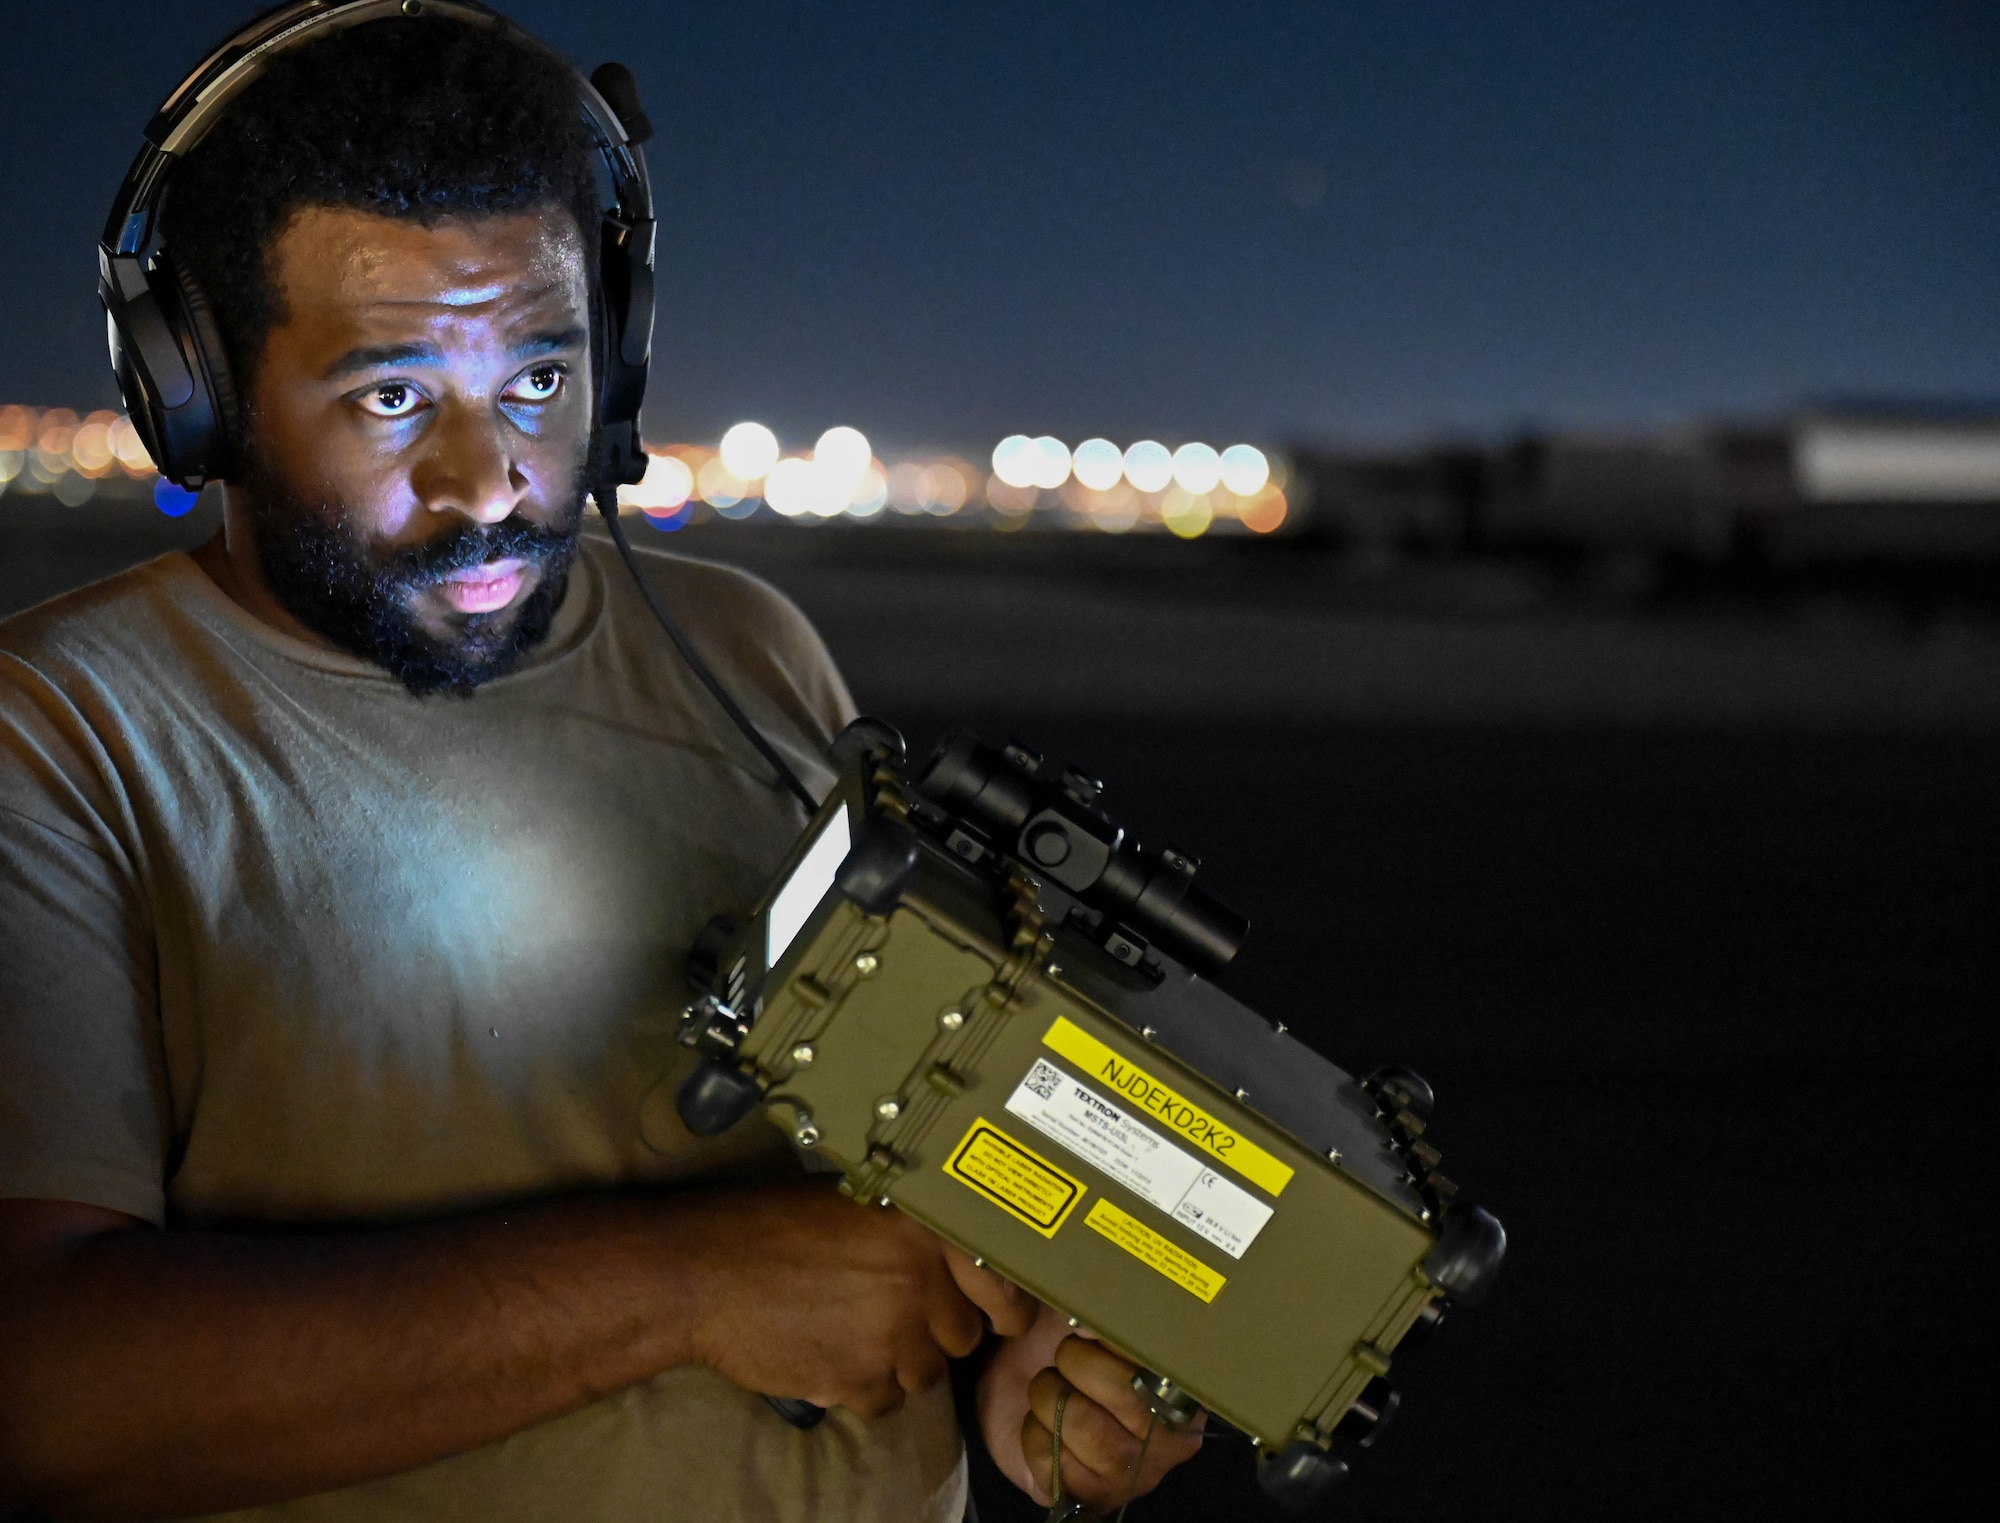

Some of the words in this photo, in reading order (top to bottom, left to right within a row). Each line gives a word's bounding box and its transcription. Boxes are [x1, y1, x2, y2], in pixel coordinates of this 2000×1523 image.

[1071, 1086, 1121, 1123] TEXTRON
[1119, 1118, 1162, 1150] Systems
[1099, 1057, 1238, 1158] NJDEKD2K2
[964, 1162, 986, 1179] CLASS
[995, 1182, 1017, 1199] LASER
[1015, 1195, 1046, 1218] PRODUCT
[968, 1153, 986, 1166] WITH
[984, 1163, 1011, 1183] OPTICAL
[1011, 1180, 1055, 1211] INSTRUMENTS
[981, 1137, 1011, 1159] INVISIBLE
[1010, 1156, 1033, 1173] LASER
[1031, 1170, 1065, 1194] RADIATION
[982, 1150, 994, 1160] DO
[992, 1156, 1007, 1168] NOT
[1006, 1165, 1023, 1179] VIEW
[1022, 1176, 1052, 1198] DIRECTLY
[1098, 1212, 1119, 1228] Avoid
[1187, 1271, 1211, 1289] during
[1151, 1236, 1163, 1246] UV
[1161, 1243, 1199, 1270] RADIATION
